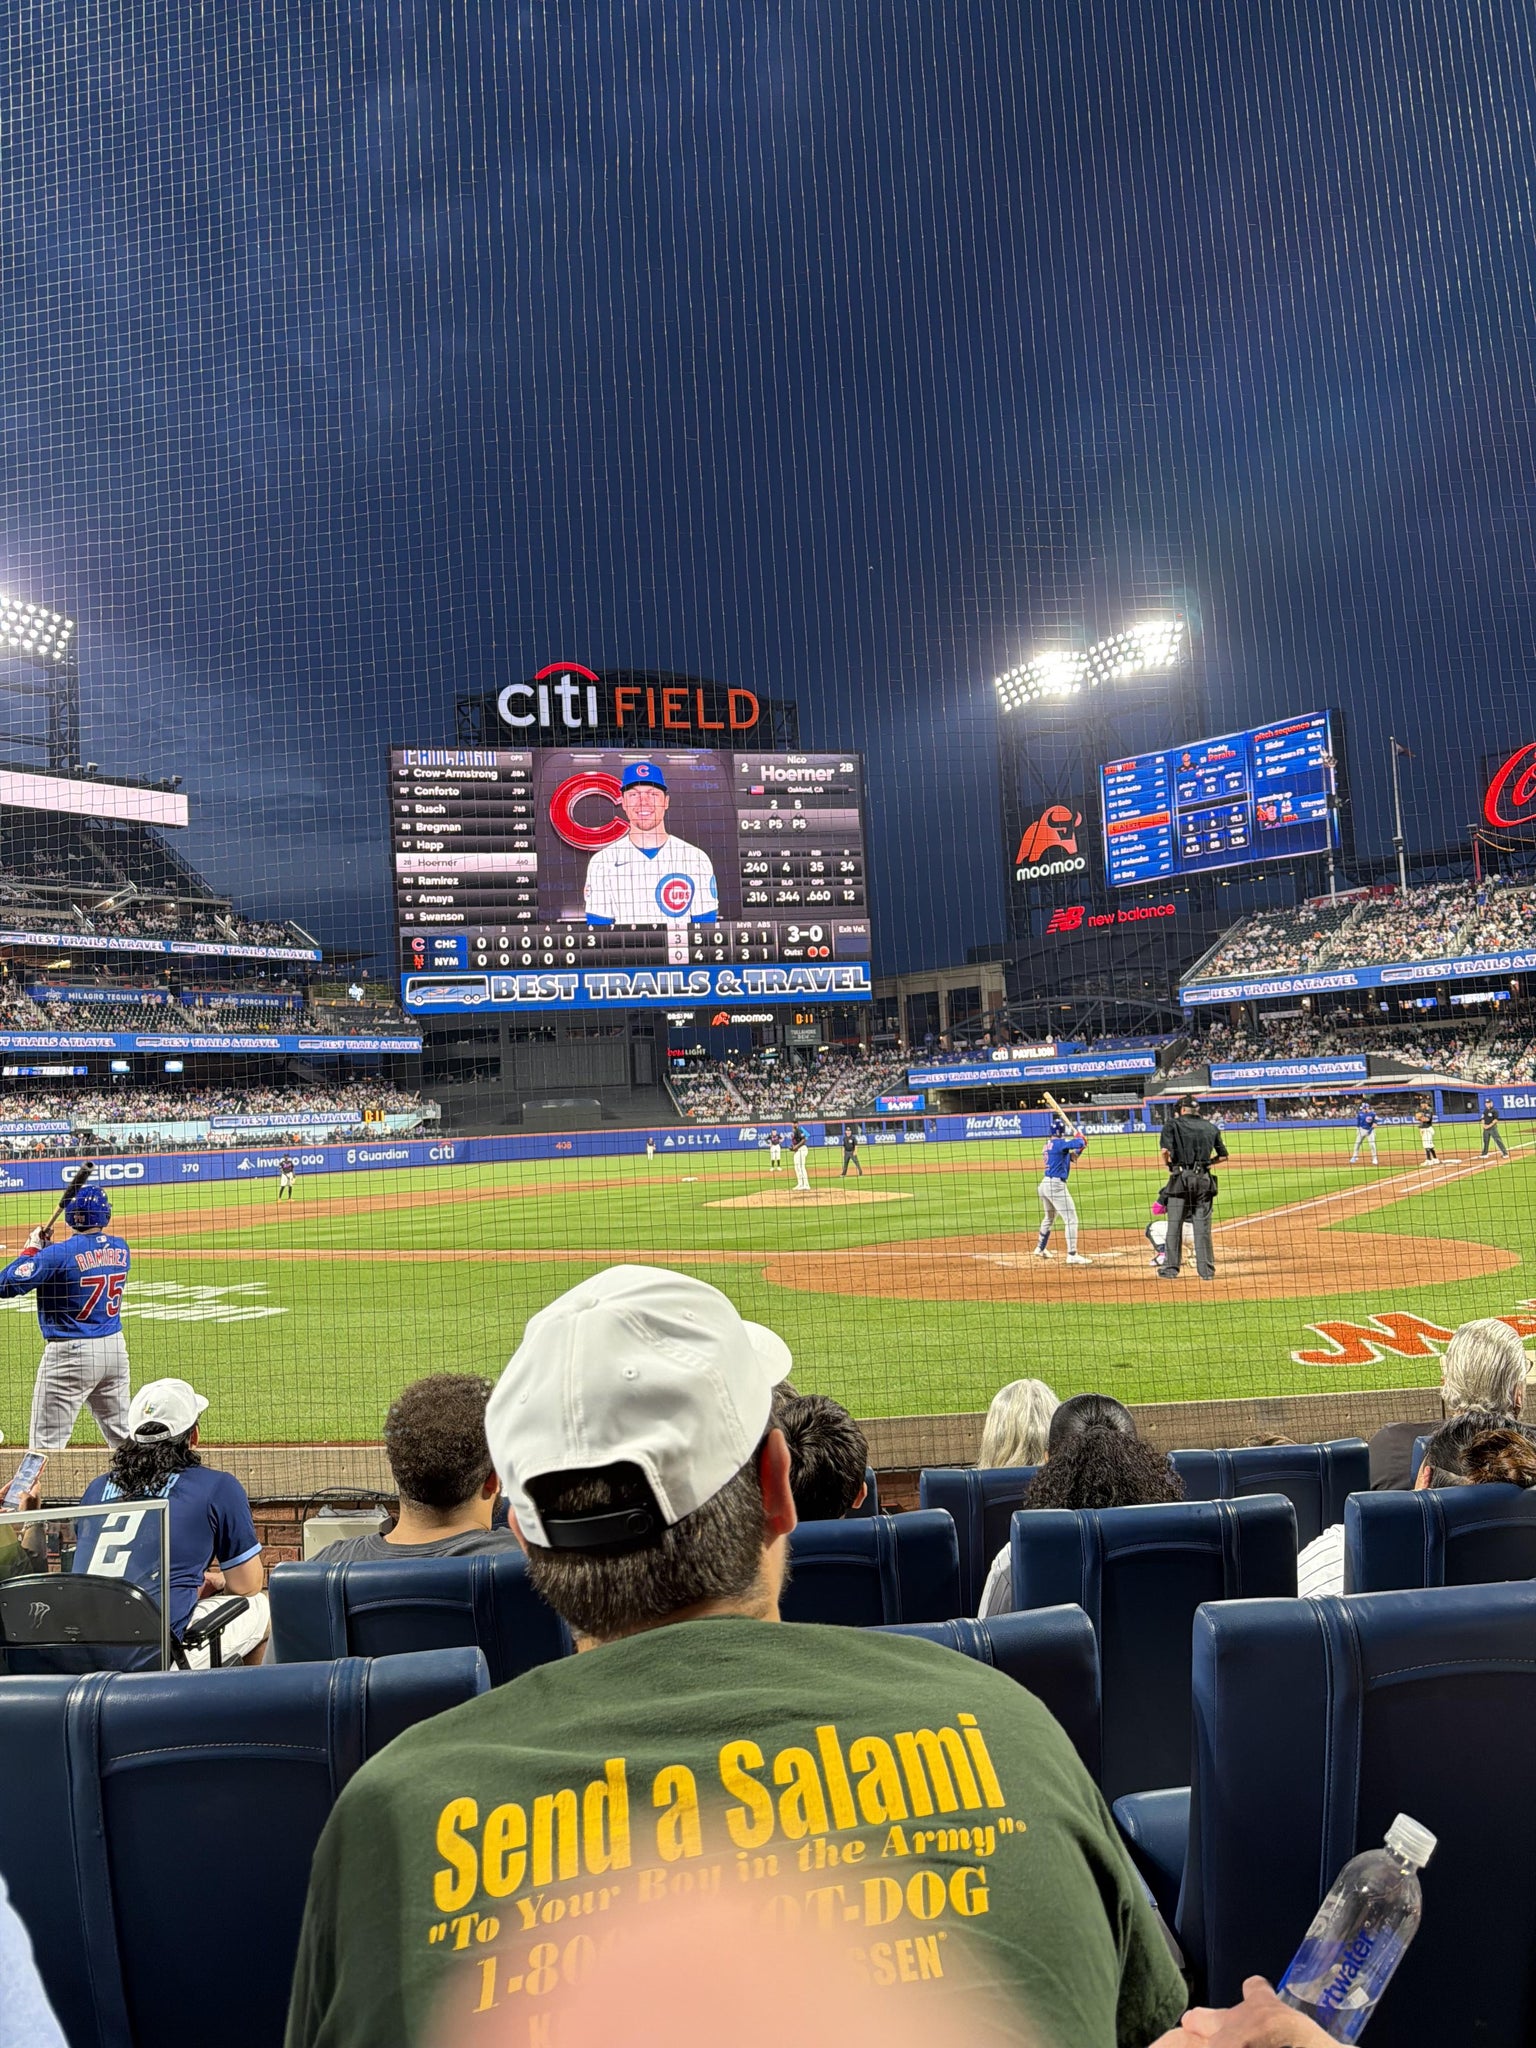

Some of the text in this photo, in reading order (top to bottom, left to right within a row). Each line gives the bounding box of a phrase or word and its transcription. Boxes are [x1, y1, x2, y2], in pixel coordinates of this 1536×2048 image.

[497, 673, 760, 730] citi FIELD
[1254, 730, 1274, 742] pitch
[1264, 740, 1285, 750] Slider
[1208, 750, 1236, 763] Peralta
[741, 756, 854, 772] 2 Nico 2B
[413, 768, 498, 781] Crow-Armstrong
[760, 766, 835, 781] Hoerner
[1266, 766, 1287, 776] Slider
[414, 786, 460, 796] Conforto
[415, 804, 446, 814] Busch
[770, 800, 802, 809] 2 5
[416, 822, 462, 834] Bregman
[741, 819, 807, 829] 0-2 P5 P5
[417, 840, 444, 851] Happ
[418, 859, 458, 867] Hoerner
[743, 861, 855, 873] .240 4 35 34
[1016, 857, 1086, 881] moomoo
[418, 894, 454, 905] Amaya
[746, 890, 855, 902] .316 .344 .660 12
[420, 912, 464, 921] Swanson
[1088, 903, 1176, 928] new balance
[788, 925, 823, 942] 3-0
[28, 933, 165, 951] BEST TRAILS TRAVEL
[435, 932, 767, 949] CHC 0 0 0 0 0 3 3 5 0 3 1
[435, 948, 768, 966] NYM 0 0 0 0 0 0 4 2 3 1
[1414, 964, 1452, 978] BEST
[1453, 958, 1511, 974] TRAILS
[1512, 956, 1526, 968] &
[491, 966, 871, 1002] BEST TRAILS & TRAVEL
[1210, 974, 1358, 999] BEST TRAILS TRAVEL
[107, 993, 139, 1001] TEQUILA
[731, 1013, 773, 1023] moomoo
[12, 1037, 58, 1047] TRAILS
[69, 1037, 116, 1047] TRAVEL
[1013, 1047, 1055, 1059] PAVILION
[1236, 1061, 1366, 1079] BEST TRAILS TRAVEL
[966, 1115, 1022, 1130] Hard Rock
[1377, 1115, 1438, 1125] CADILLC
[1085, 1124, 1124, 1134] DUNKIN'
[1132, 1123, 1146, 1132] 370
[677, 1134, 721, 1145] DELTA
[824, 1136, 839, 1145] 380
[429, 1142, 455, 1160] citi
[555, 1142, 572, 1150] 408
[257, 1154, 324, 1168] Inveo QQQ
[359, 1149, 409, 1161] Guardian
[61, 1163, 145, 1182] GEICO
[181, 1163, 199, 1173] 370
[75, 1273, 127, 1320] 75
[87, 1510, 146, 1577] 2
[434, 1713, 1005, 1912] Send a Salami
[429, 1913, 500, 1951] "To
[516, 1885, 621, 1931] Your
[637, 1864, 721, 1905] Boy
[736, 1851, 779, 1884] in
[797, 1838, 867, 1873] the
